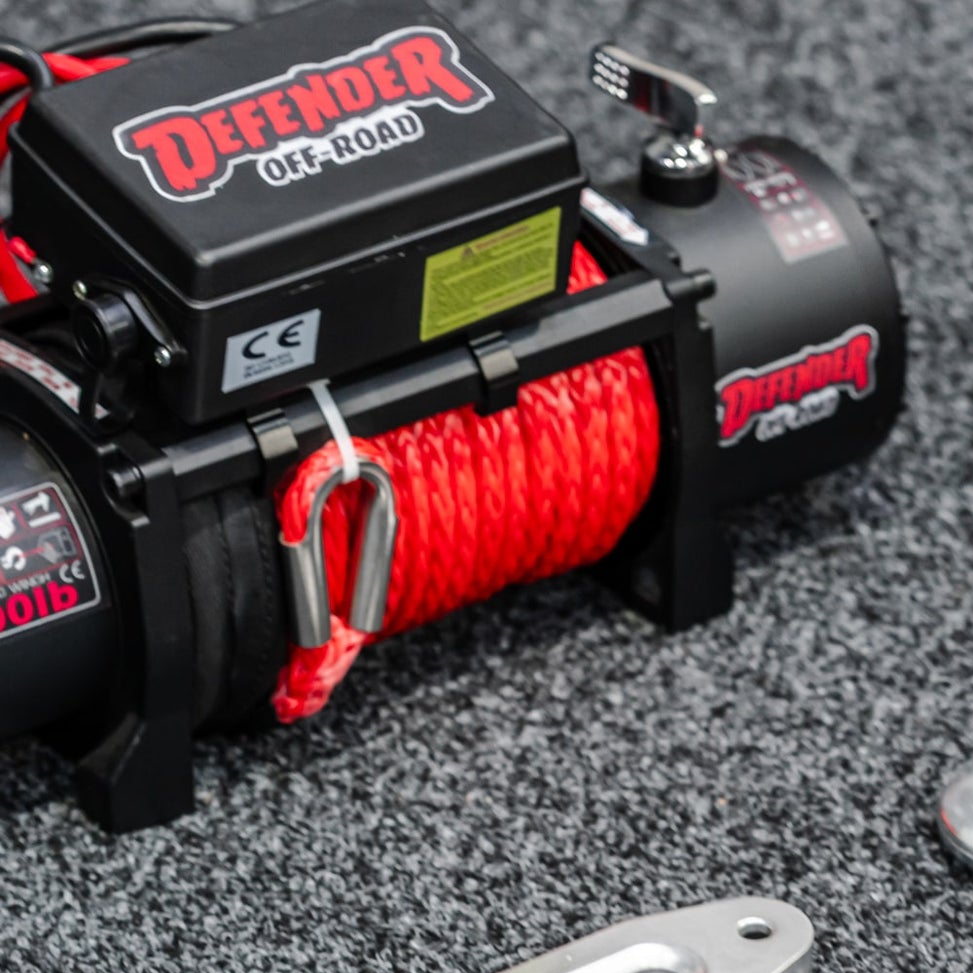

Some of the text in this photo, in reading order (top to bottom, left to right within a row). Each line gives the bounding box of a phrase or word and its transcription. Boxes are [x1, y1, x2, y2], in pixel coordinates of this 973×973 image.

[131, 35, 476, 193] DEFENDER
[263, 112, 419, 180] OFF-ROAD
[242, 319, 304, 360] CE
[59, 559, 86, 584] CE
[0, 580, 79, 634] 0lb
